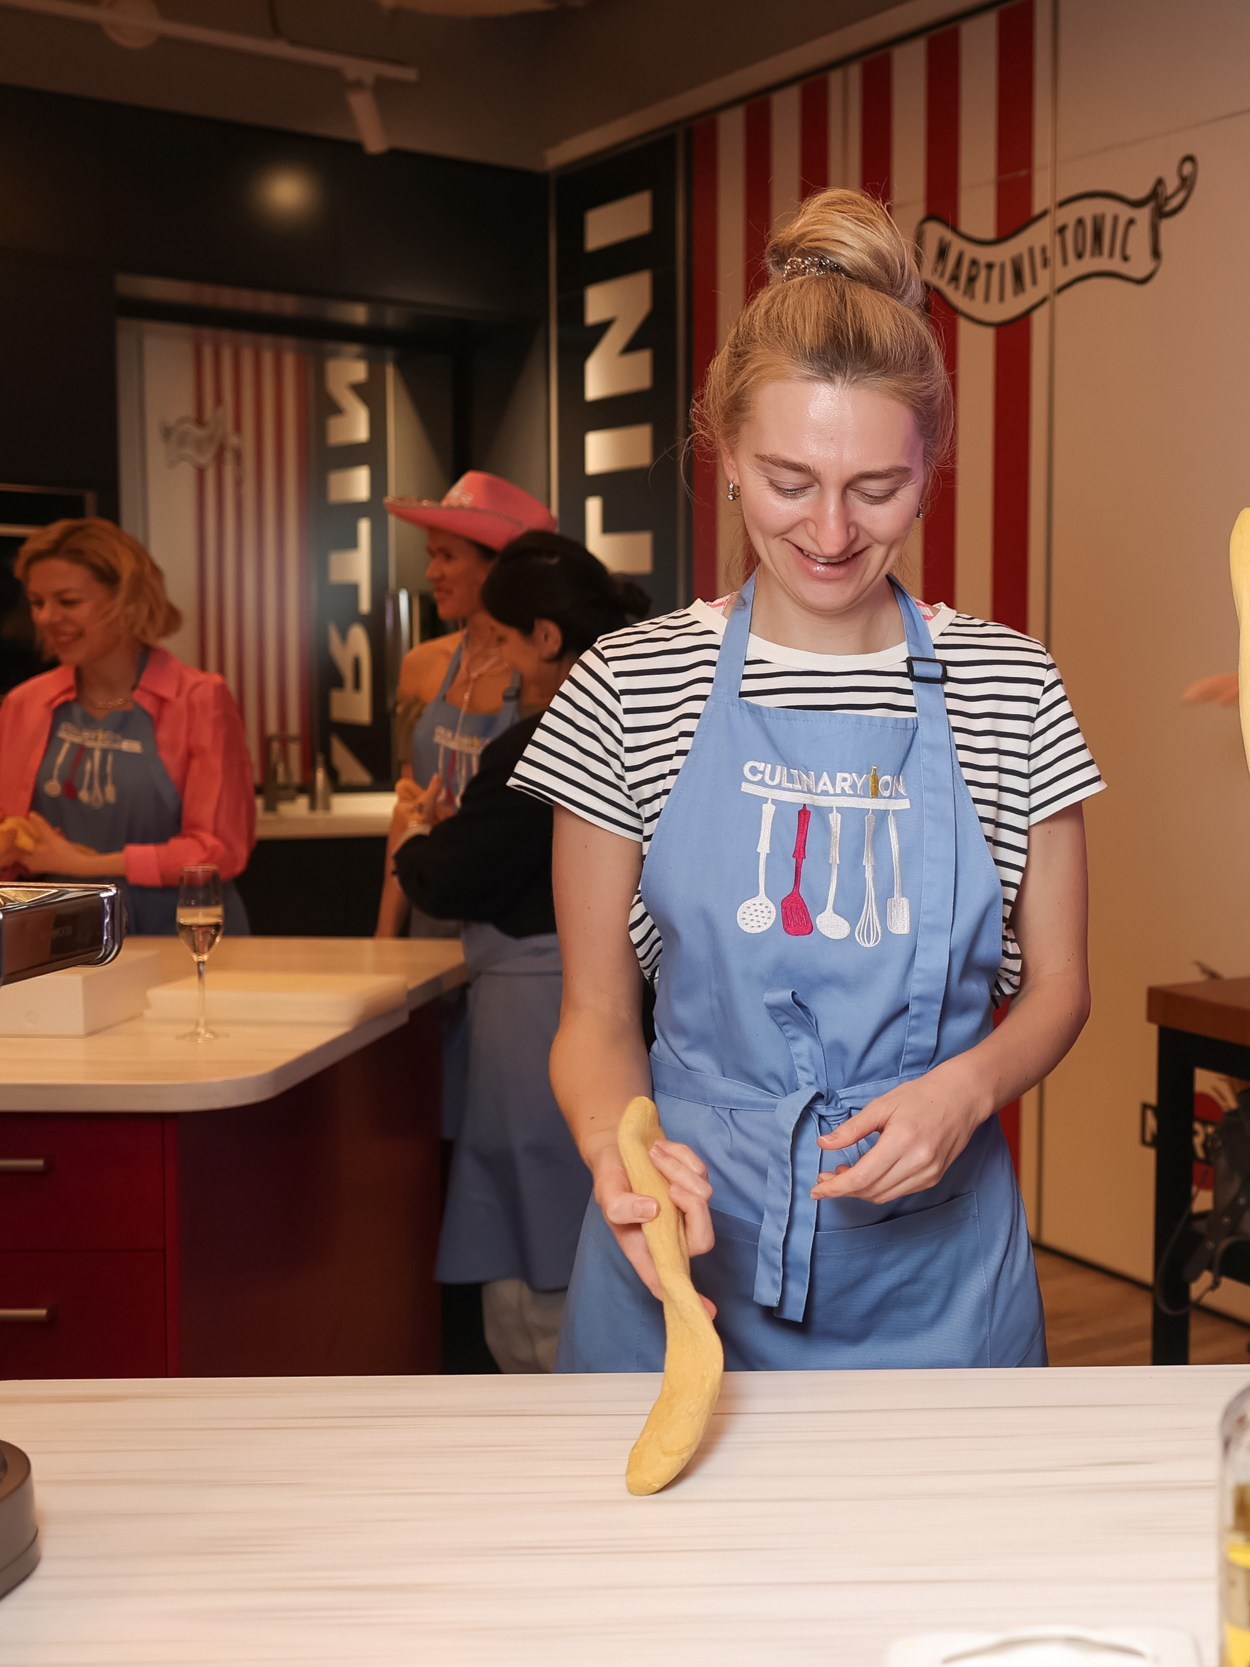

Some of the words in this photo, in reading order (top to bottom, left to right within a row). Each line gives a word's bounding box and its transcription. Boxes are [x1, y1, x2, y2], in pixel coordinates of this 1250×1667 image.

[931, 235, 1038, 304] MARTINI
[1056, 213, 1137, 267] TONIC
[743, 760, 869, 796] CULINARY
[878, 774, 908, 797] ON
